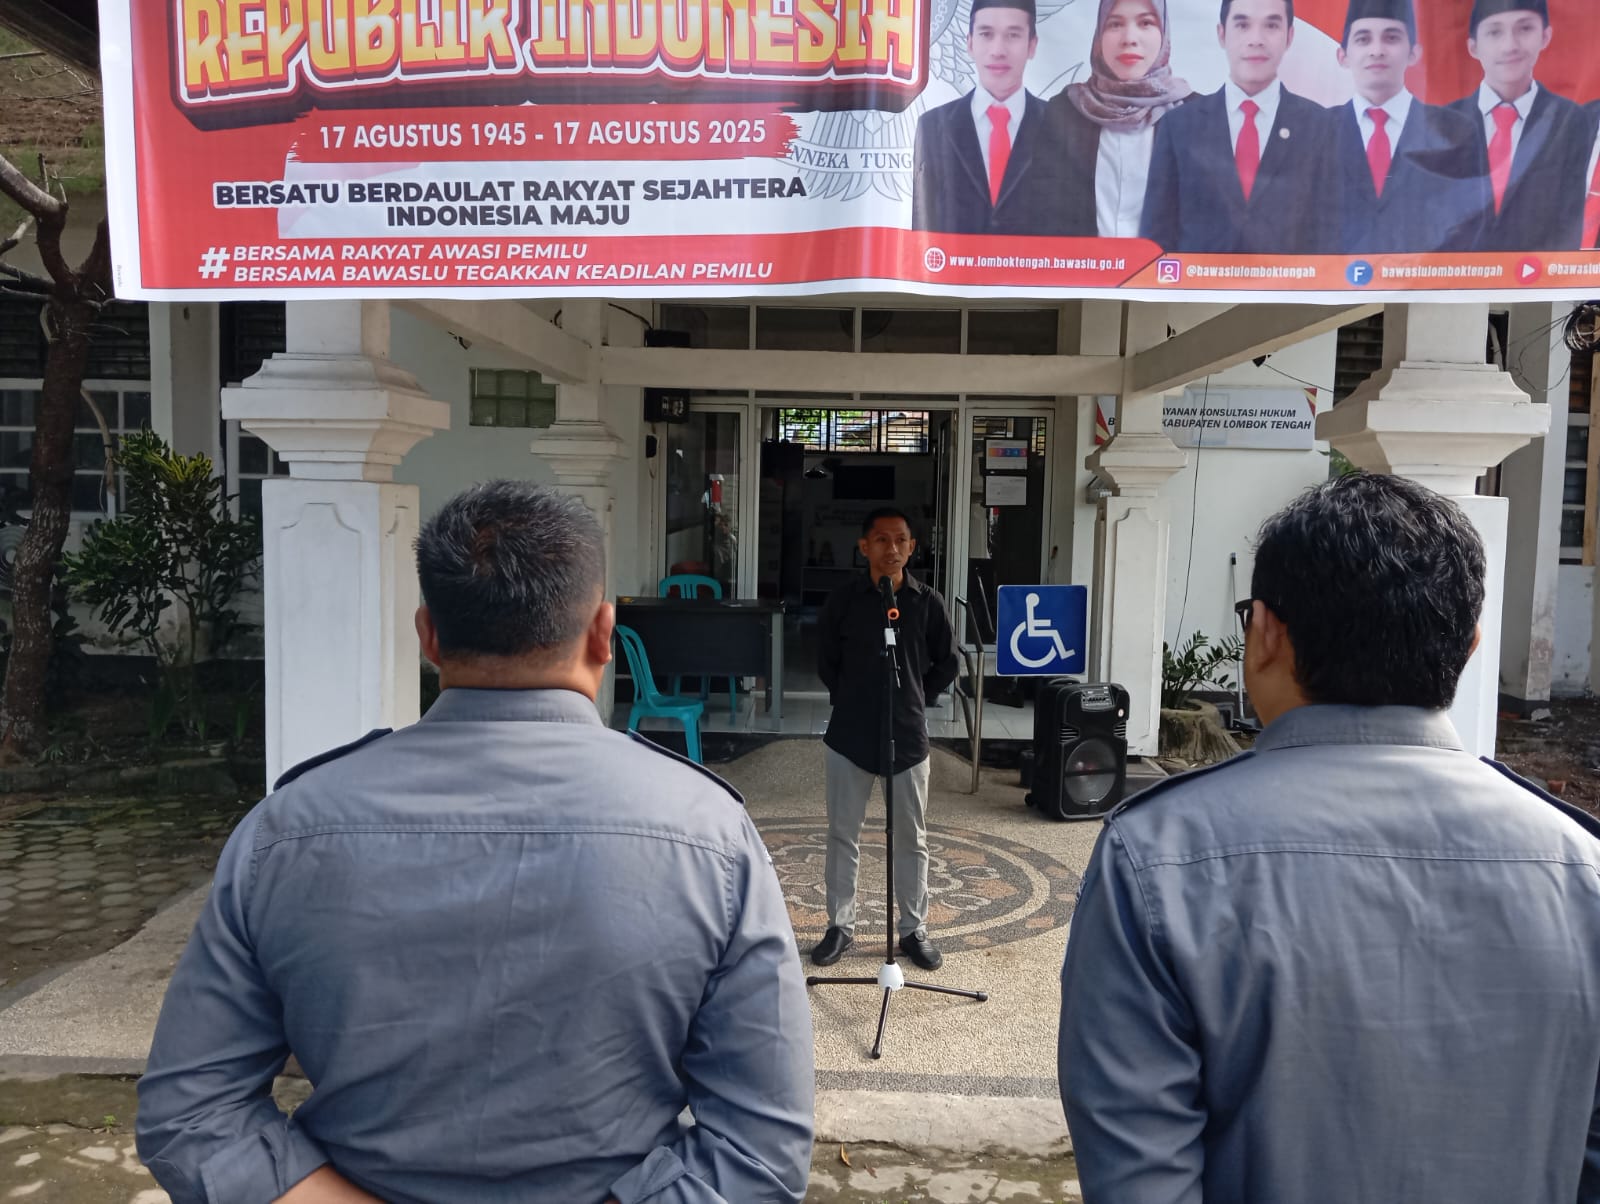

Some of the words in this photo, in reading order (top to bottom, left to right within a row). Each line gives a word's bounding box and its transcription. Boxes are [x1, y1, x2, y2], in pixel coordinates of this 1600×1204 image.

[320, 125, 346, 149] 17
[353, 122, 463, 148] AGUSTUS
[471, 122, 527, 146] 1945
[553, 121, 580, 145] 17
[587, 120, 700, 145] AGUSTUS
[707, 119, 767, 144] 2025
[215, 183, 339, 206] BERSATU
[348, 181, 515, 203] BERDAULAT
[523, 180, 635, 200] RAKYAT
[642, 176, 808, 200] SEJAHTERA
[387, 204, 543, 226] INDONESIA
[550, 204, 630, 226] MAJU
[233, 245, 335, 262] BERSAMA
[341, 244, 424, 261] RAKYAT
[429, 244, 501, 260] AWASI
[506, 244, 588, 260] PEMILU
[234, 265, 336, 282] BERSAMA
[342, 264, 448, 281] BAWASLU
[454, 264, 566, 280] TEGAKKAN
[576, 263, 685, 280] KEADILAN
[691, 262, 774, 279] PEMILU
[949, 255, 1126, 271] www.lomboktengah.bawaslu.go.id
[1381, 264, 1504, 278] bawaslulomboktengah
[1200, 408, 1257, 417] KONSULTASI
[1260, 409, 1296, 418] HUKUM
[1223, 420, 1267, 430] LOMBOK
[1270, 420, 1311, 430] TENGAH
